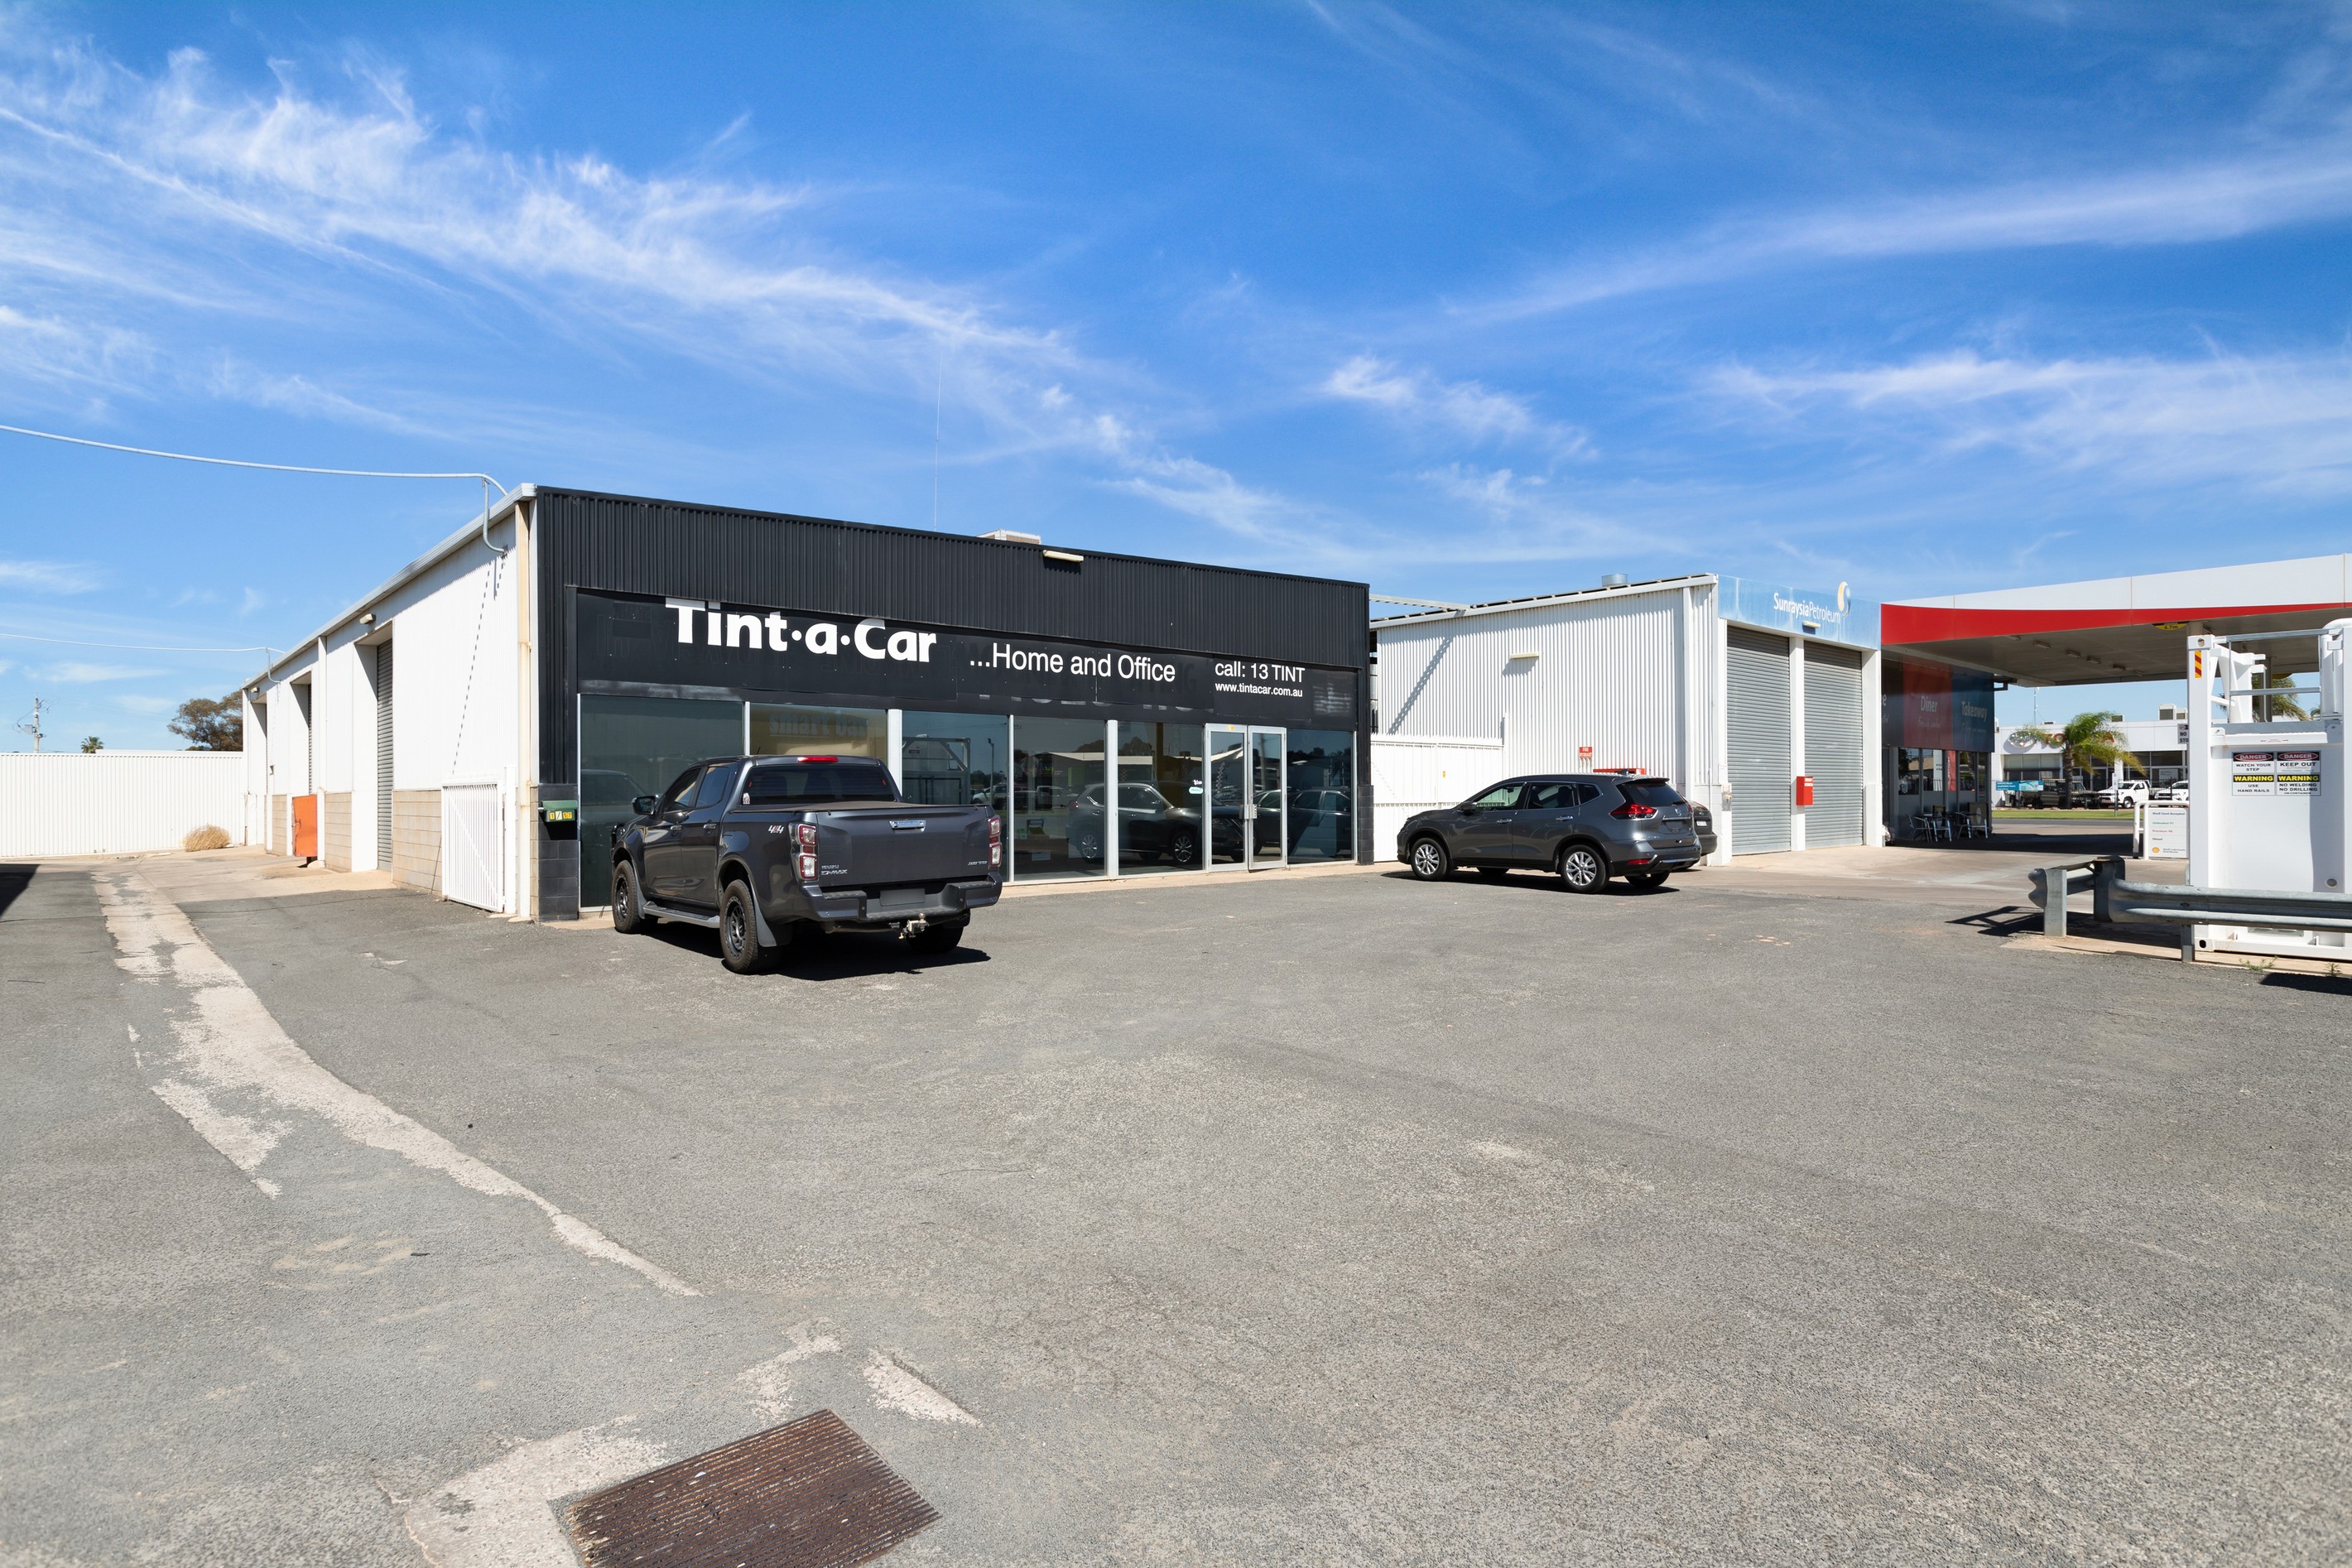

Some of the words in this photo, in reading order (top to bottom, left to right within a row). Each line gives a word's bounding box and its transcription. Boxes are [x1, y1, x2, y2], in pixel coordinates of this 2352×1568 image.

[1070, 654, 1111, 677] and
[1118, 655, 1176, 682] Office
[1214, 661, 1246, 677] call:
[1251, 663, 1268, 679] 13
[1272, 665, 1306, 683] TINT
[1214, 683, 1303, 698] www.tintacar.com.au
[1921, 696, 1937, 712] Diner
[1961, 701, 1987, 722] Takeaway
